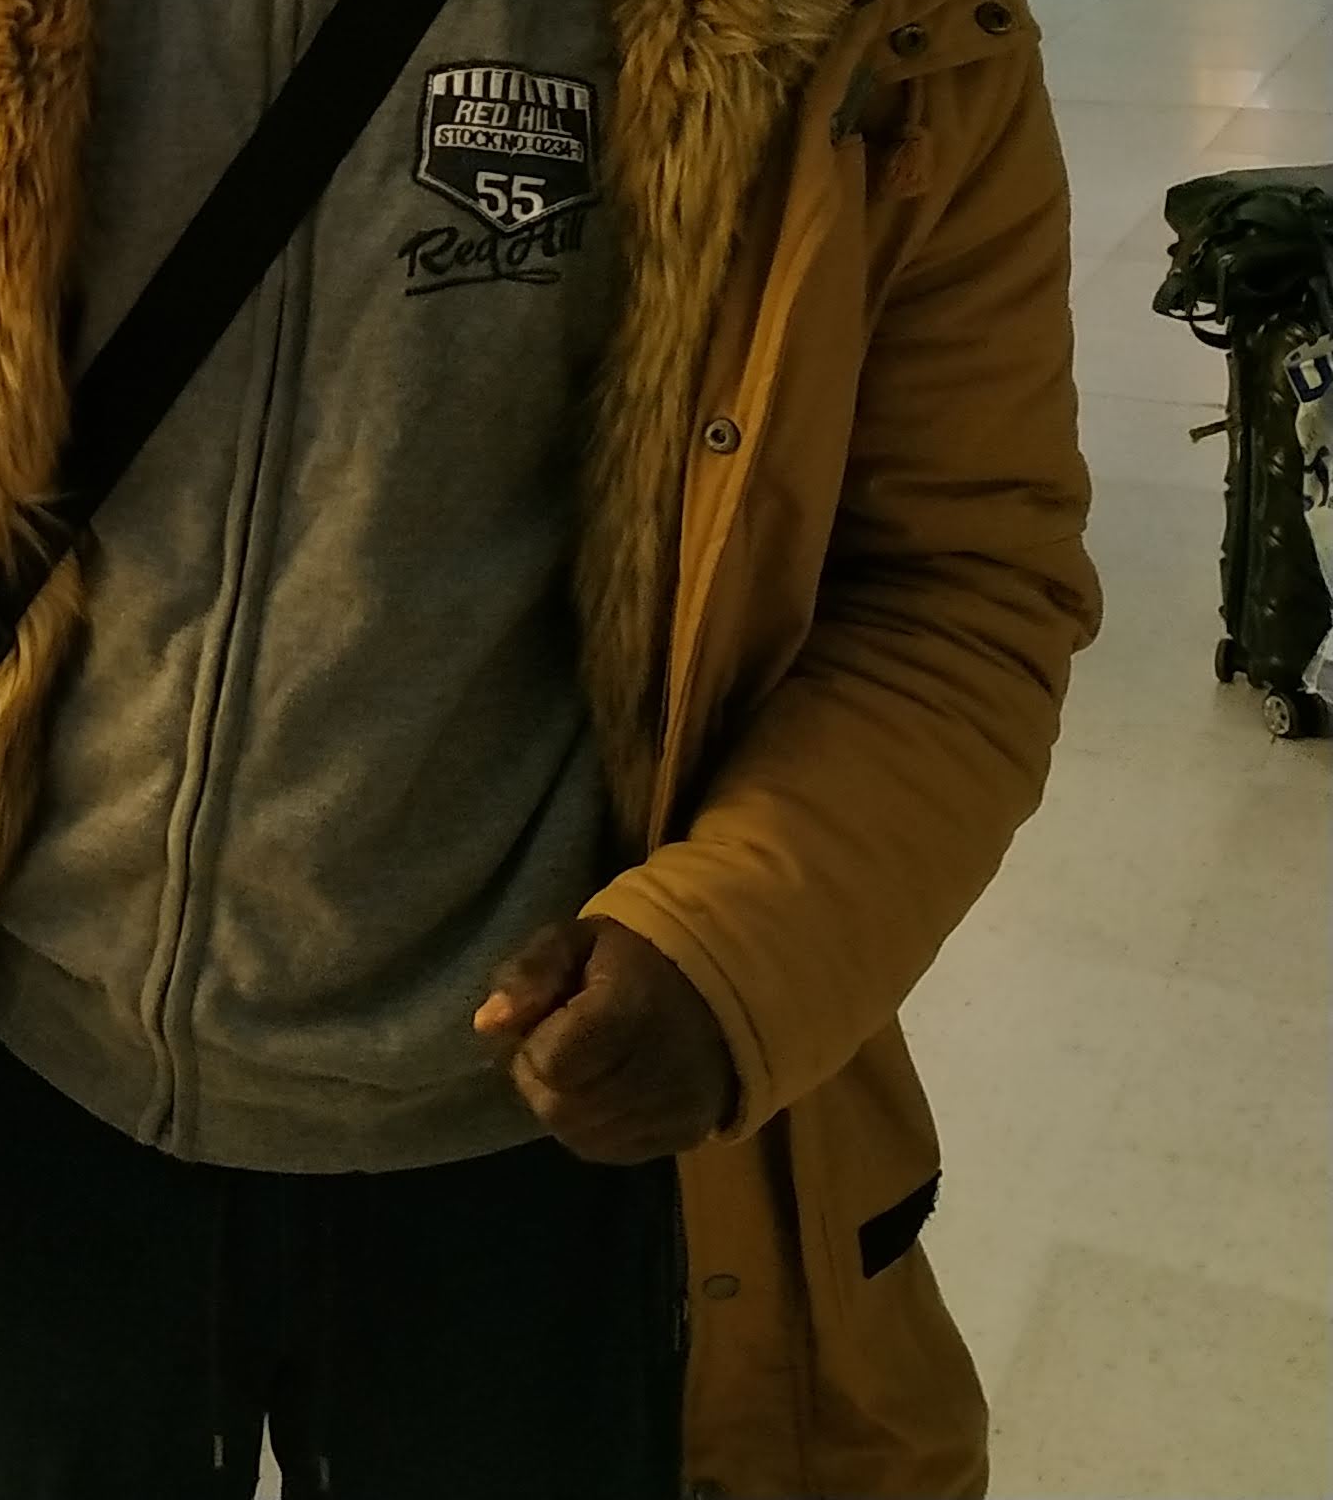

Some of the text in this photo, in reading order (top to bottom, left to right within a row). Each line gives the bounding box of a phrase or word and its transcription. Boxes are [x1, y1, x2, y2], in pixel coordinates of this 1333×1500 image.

[453, 99, 573, 136] RED HILL
[475, 171, 546, 222] 55
